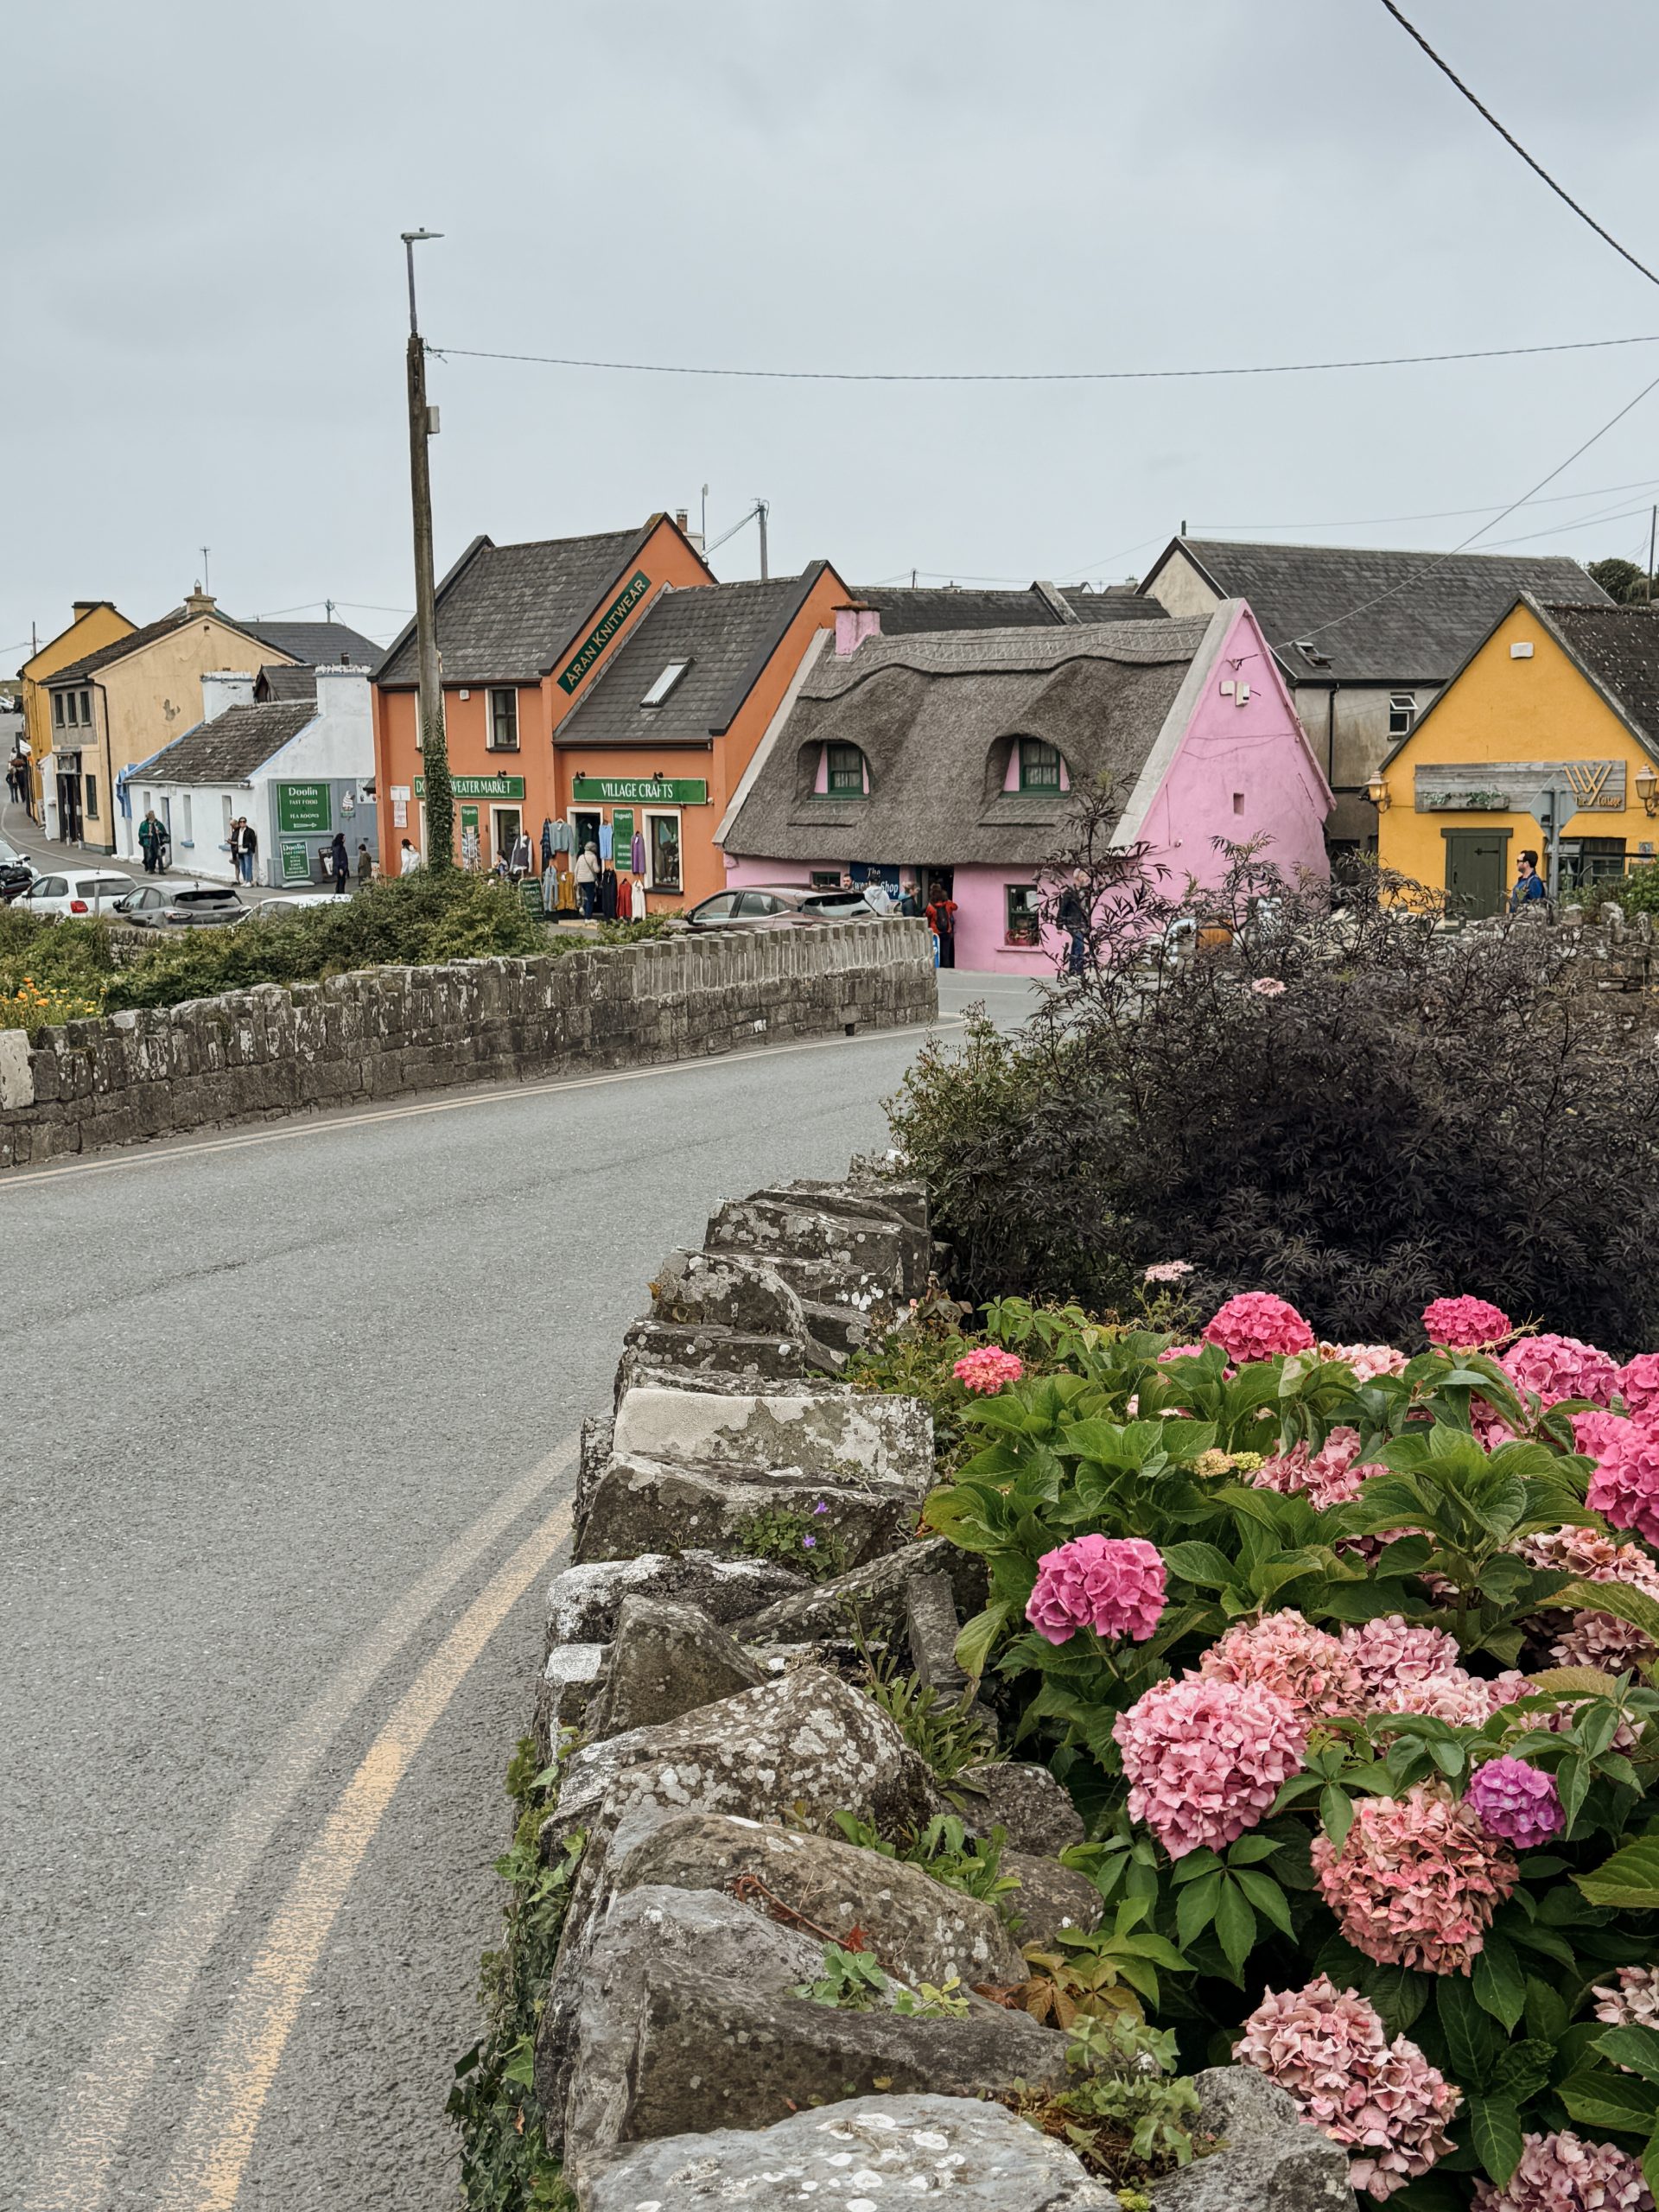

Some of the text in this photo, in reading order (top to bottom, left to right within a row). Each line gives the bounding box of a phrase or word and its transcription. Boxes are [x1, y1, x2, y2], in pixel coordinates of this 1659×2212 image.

[565, 579, 646, 686] ARAN KNITWEAR
[288, 786, 318, 796] Doolin
[449, 779, 512, 794] WEATER MARKET
[601, 782, 673, 798] VILLAGE CRAFTS
[283, 842, 306, 851] Doolin
[867, 867, 880, 879] The
[880, 880, 899, 896] Shop
